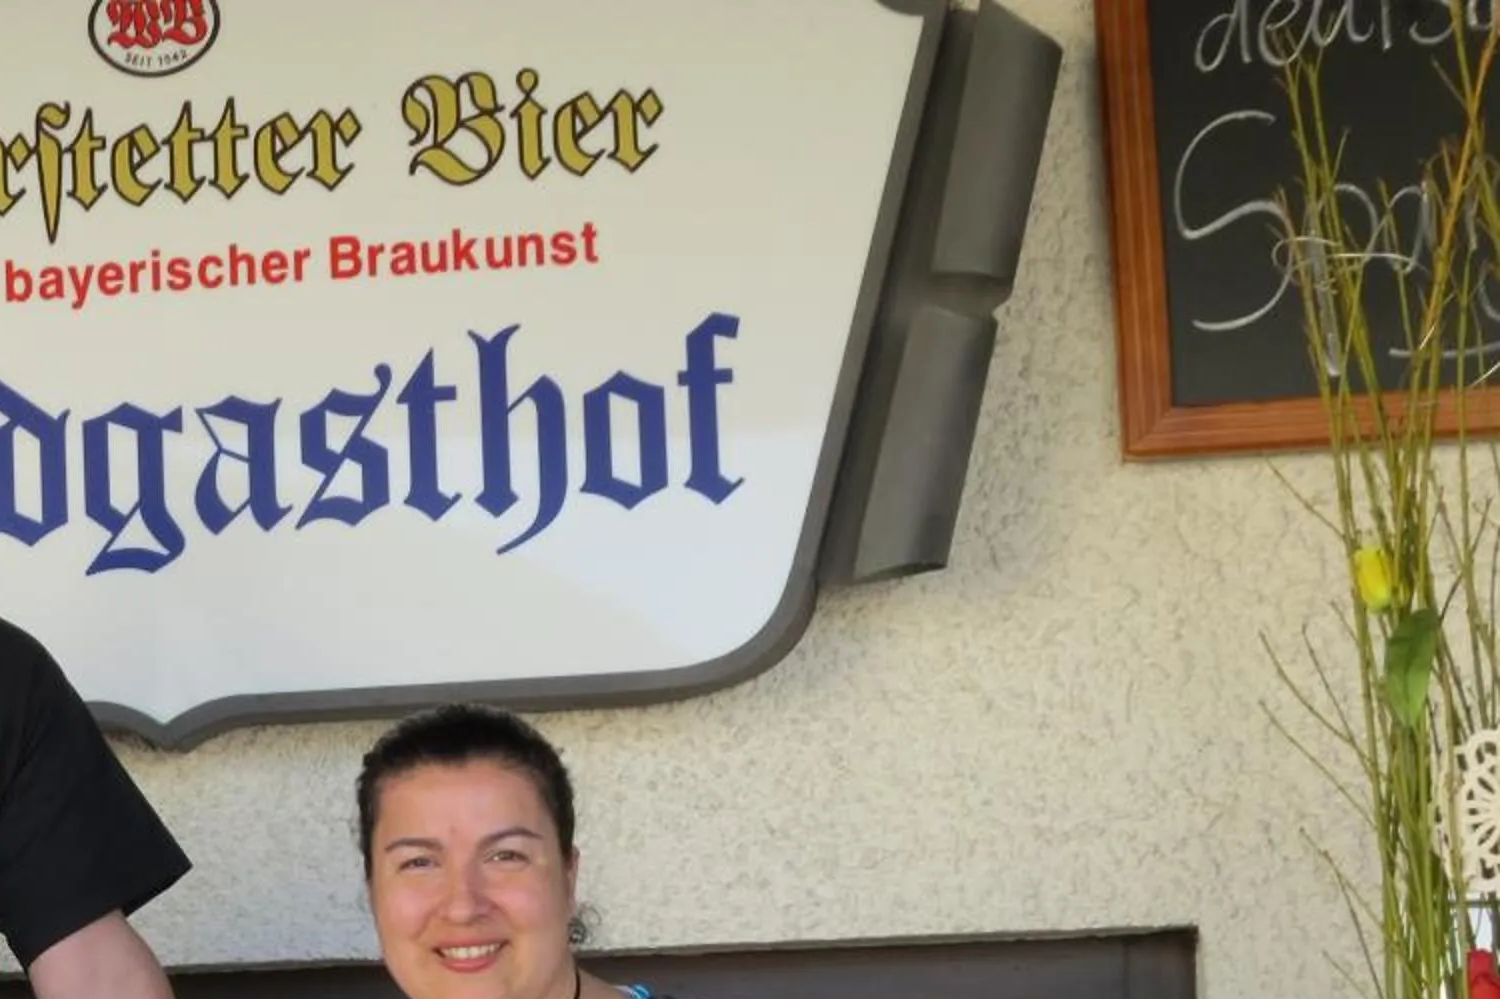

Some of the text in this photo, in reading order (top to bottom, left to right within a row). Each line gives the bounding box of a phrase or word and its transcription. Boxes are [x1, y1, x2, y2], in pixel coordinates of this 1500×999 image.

[401, 67, 665, 187] Bier
[4, 243, 311, 308] bayerischer
[329, 222, 600, 280] Braukunst
